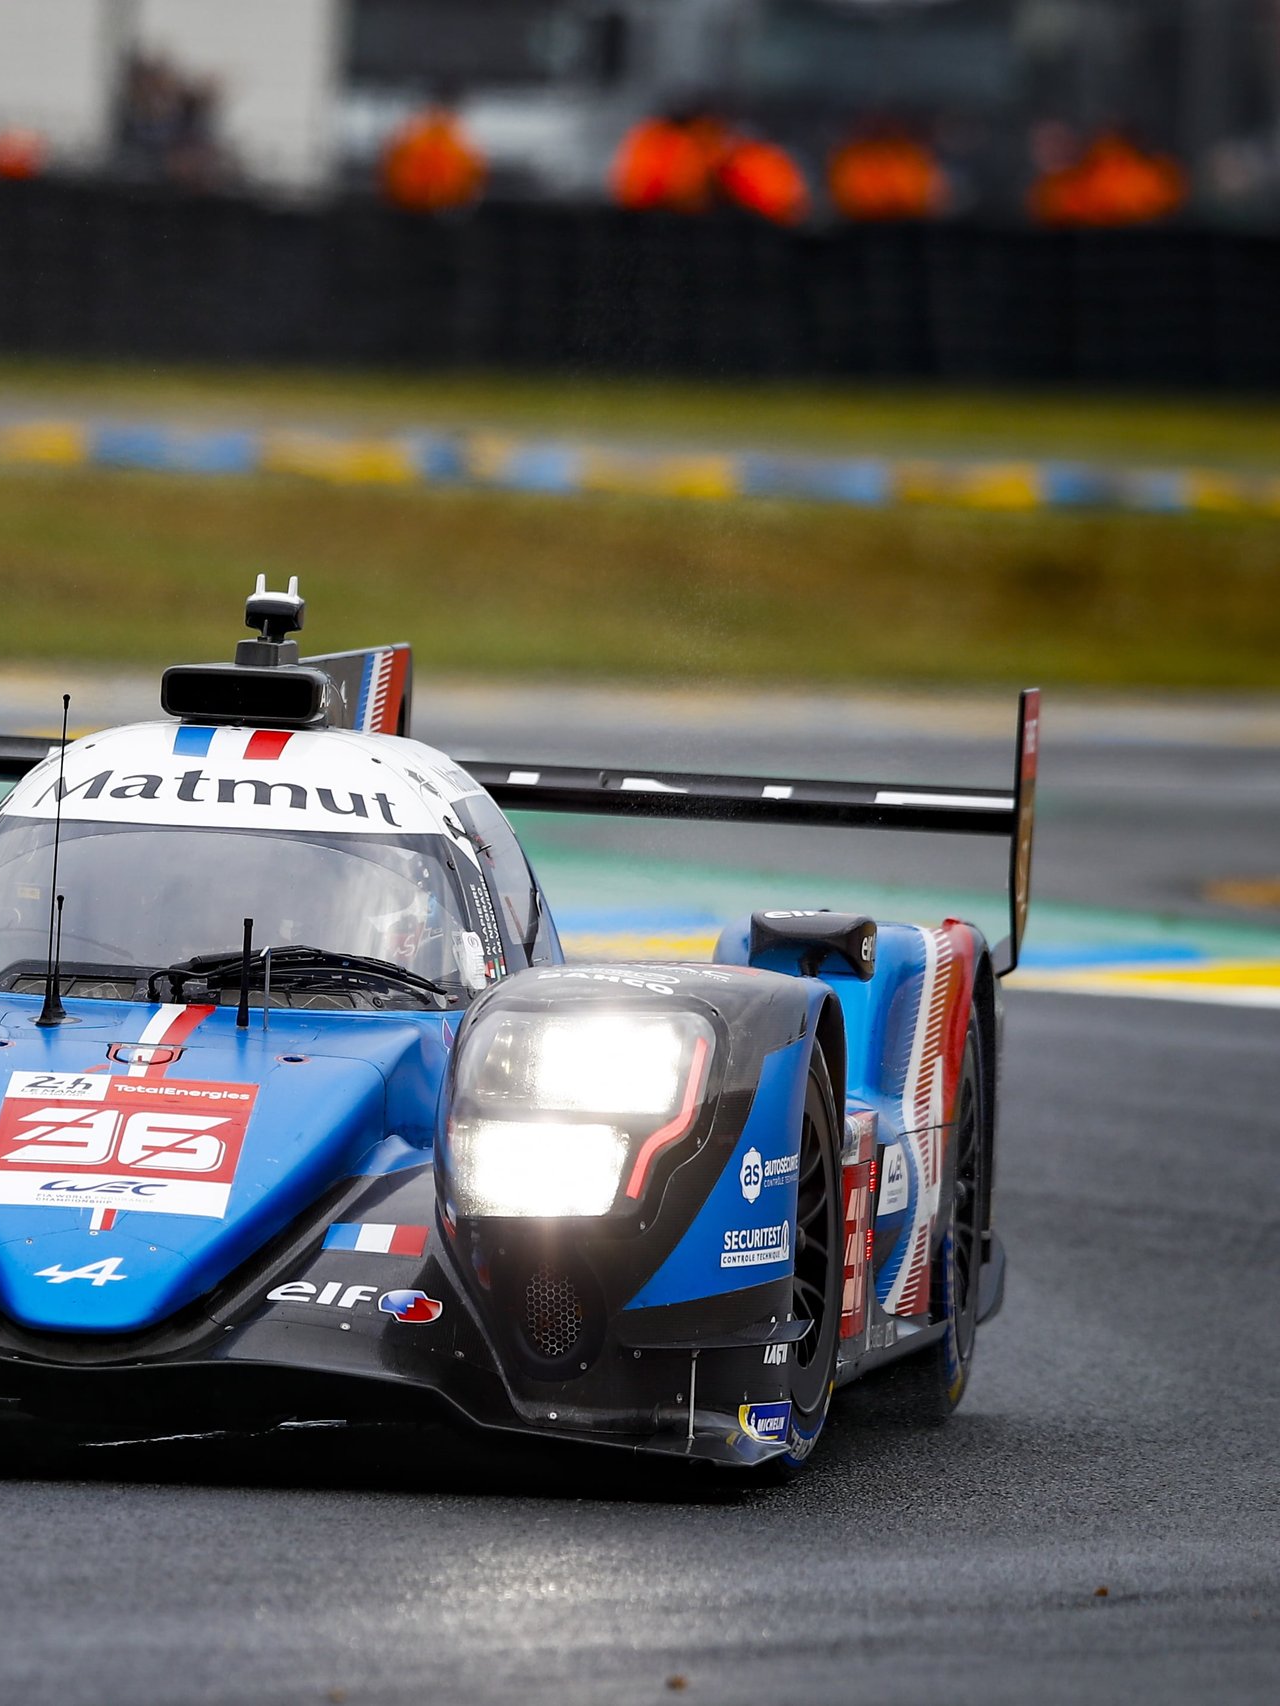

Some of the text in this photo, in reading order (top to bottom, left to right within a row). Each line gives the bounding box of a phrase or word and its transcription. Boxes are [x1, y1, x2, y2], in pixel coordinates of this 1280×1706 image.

[32, 769, 402, 828] Matmut
[114, 1083, 251, 1101] TotalEnergies
[0, 1107, 233, 1173] 36
[39, 1179, 169, 1196] WEC
[743, 1164, 760, 1187] as
[723, 1225, 782, 1251] SECURITEST
[266, 1281, 379, 1309] elf
[757, 1416, 786, 1433] MICHELIN
